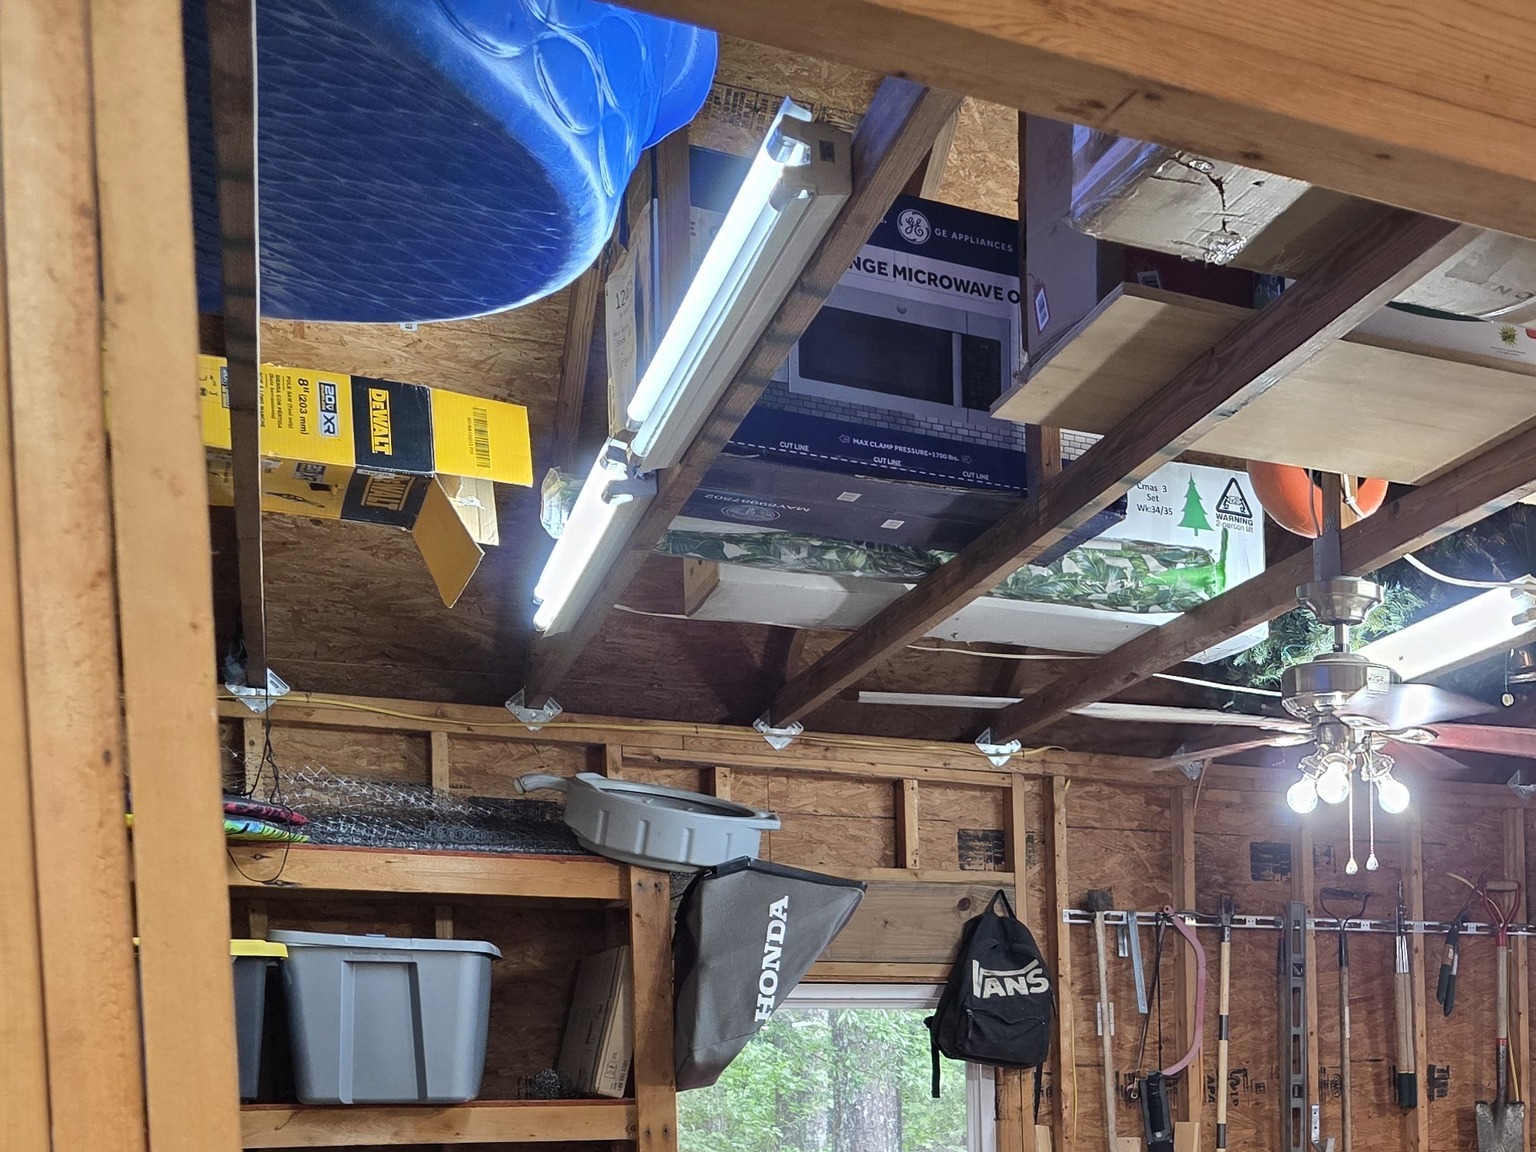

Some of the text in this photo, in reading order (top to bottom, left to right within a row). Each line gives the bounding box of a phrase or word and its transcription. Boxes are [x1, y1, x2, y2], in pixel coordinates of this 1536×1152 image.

[934, 228, 1014, 252] GE APPLIANCES
[849, 256, 888, 277] NGE
[893, 264, 1004, 301] MICROWAVE
[323, 414, 336, 434] XR
[371, 388, 392, 455] DEWALT
[779, 441, 810, 452] CUT LINE
[853, 438, 869, 447] MAX
[869, 441, 894, 450] CLAMP
[873, 456, 902, 467] CUT LINE
[1137, 482, 1168, 493] Cmas 3
[1146, 493, 1160, 502] Set
[1216, 513, 1254, 526] WARNING
[1216, 520, 1245, 532] 2-person
[754, 895, 789, 1023] HONDA
[972, 959, 1050, 999] VANS
[1206, 1074, 1216, 1104] APA
